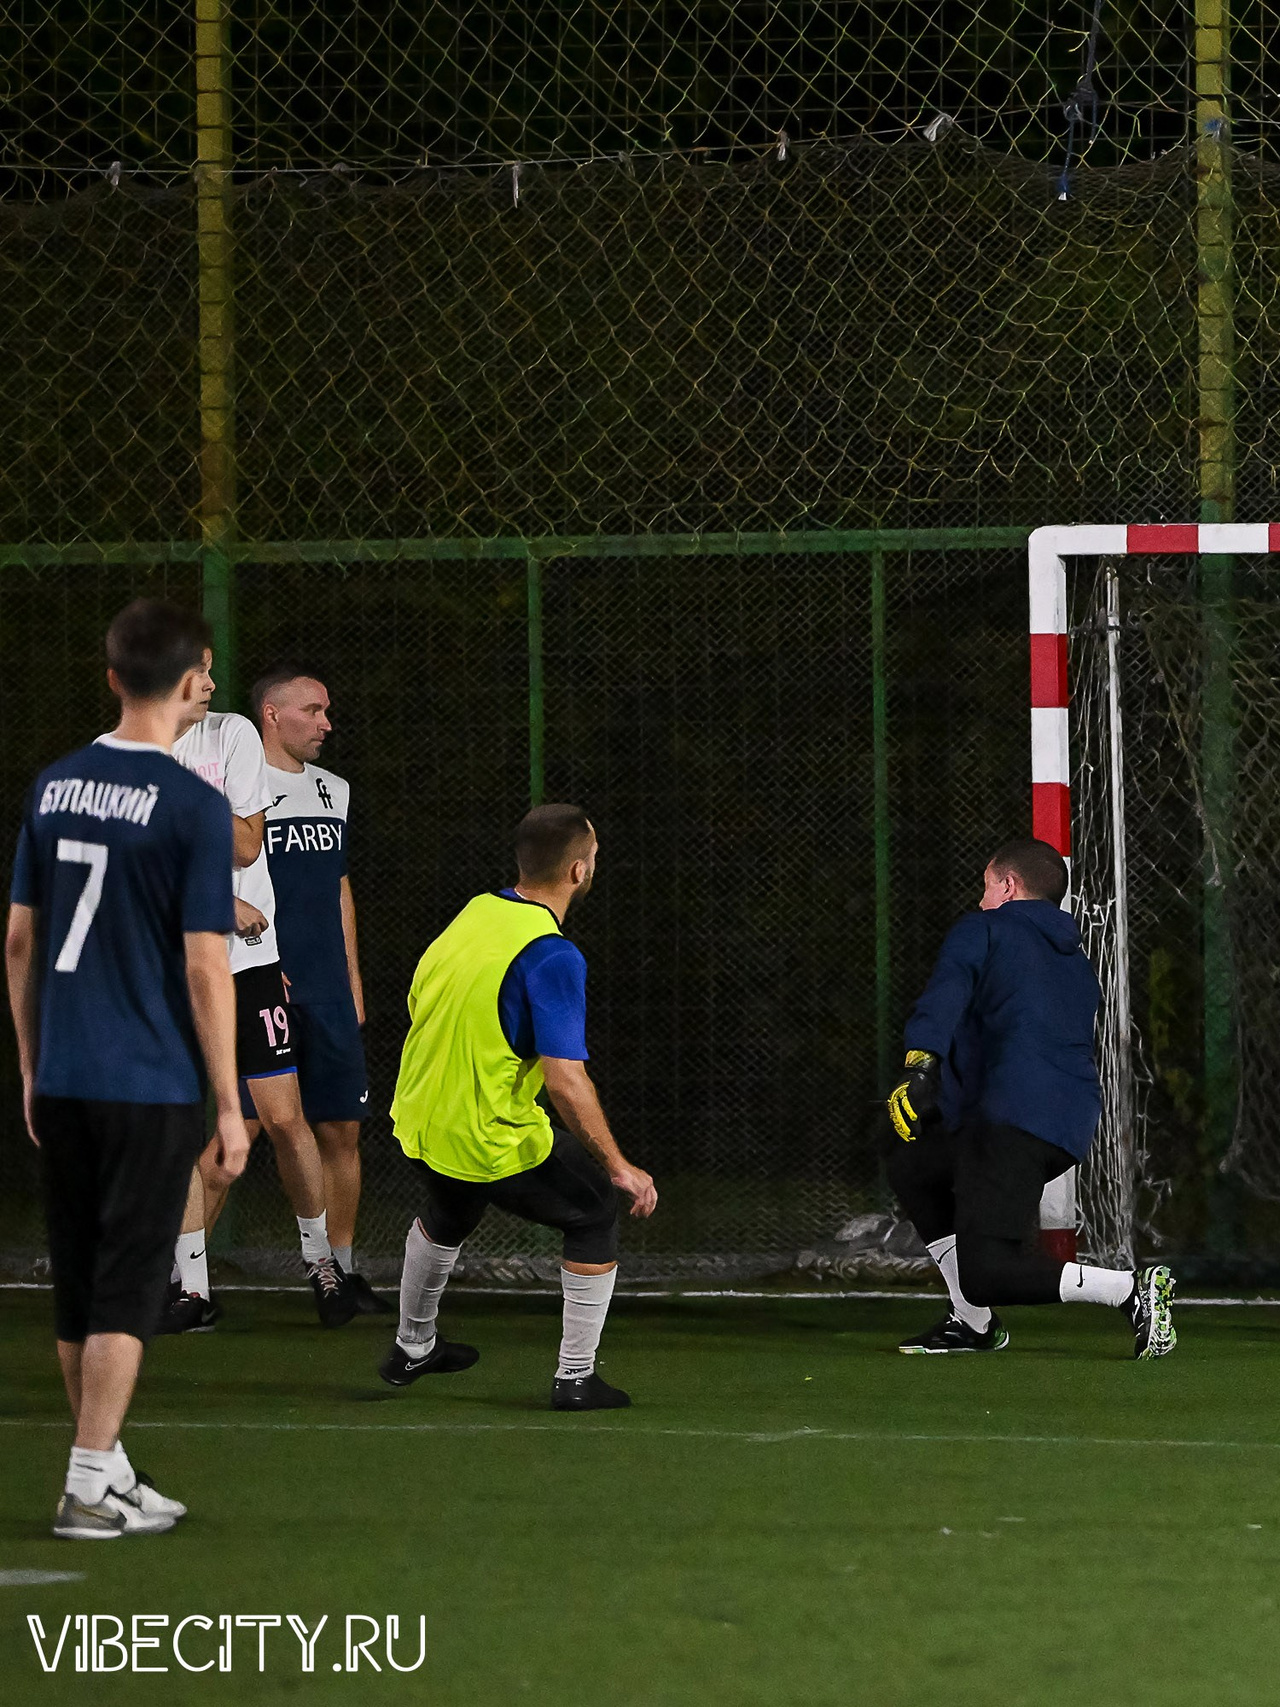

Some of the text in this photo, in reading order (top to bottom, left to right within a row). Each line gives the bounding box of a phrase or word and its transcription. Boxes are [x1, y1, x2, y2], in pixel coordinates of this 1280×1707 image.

[197, 762, 220, 778] NIT
[267, 823, 343, 854] FARBY
[55, 838, 109, 973] 7
[259, 1005, 290, 1047] 19
